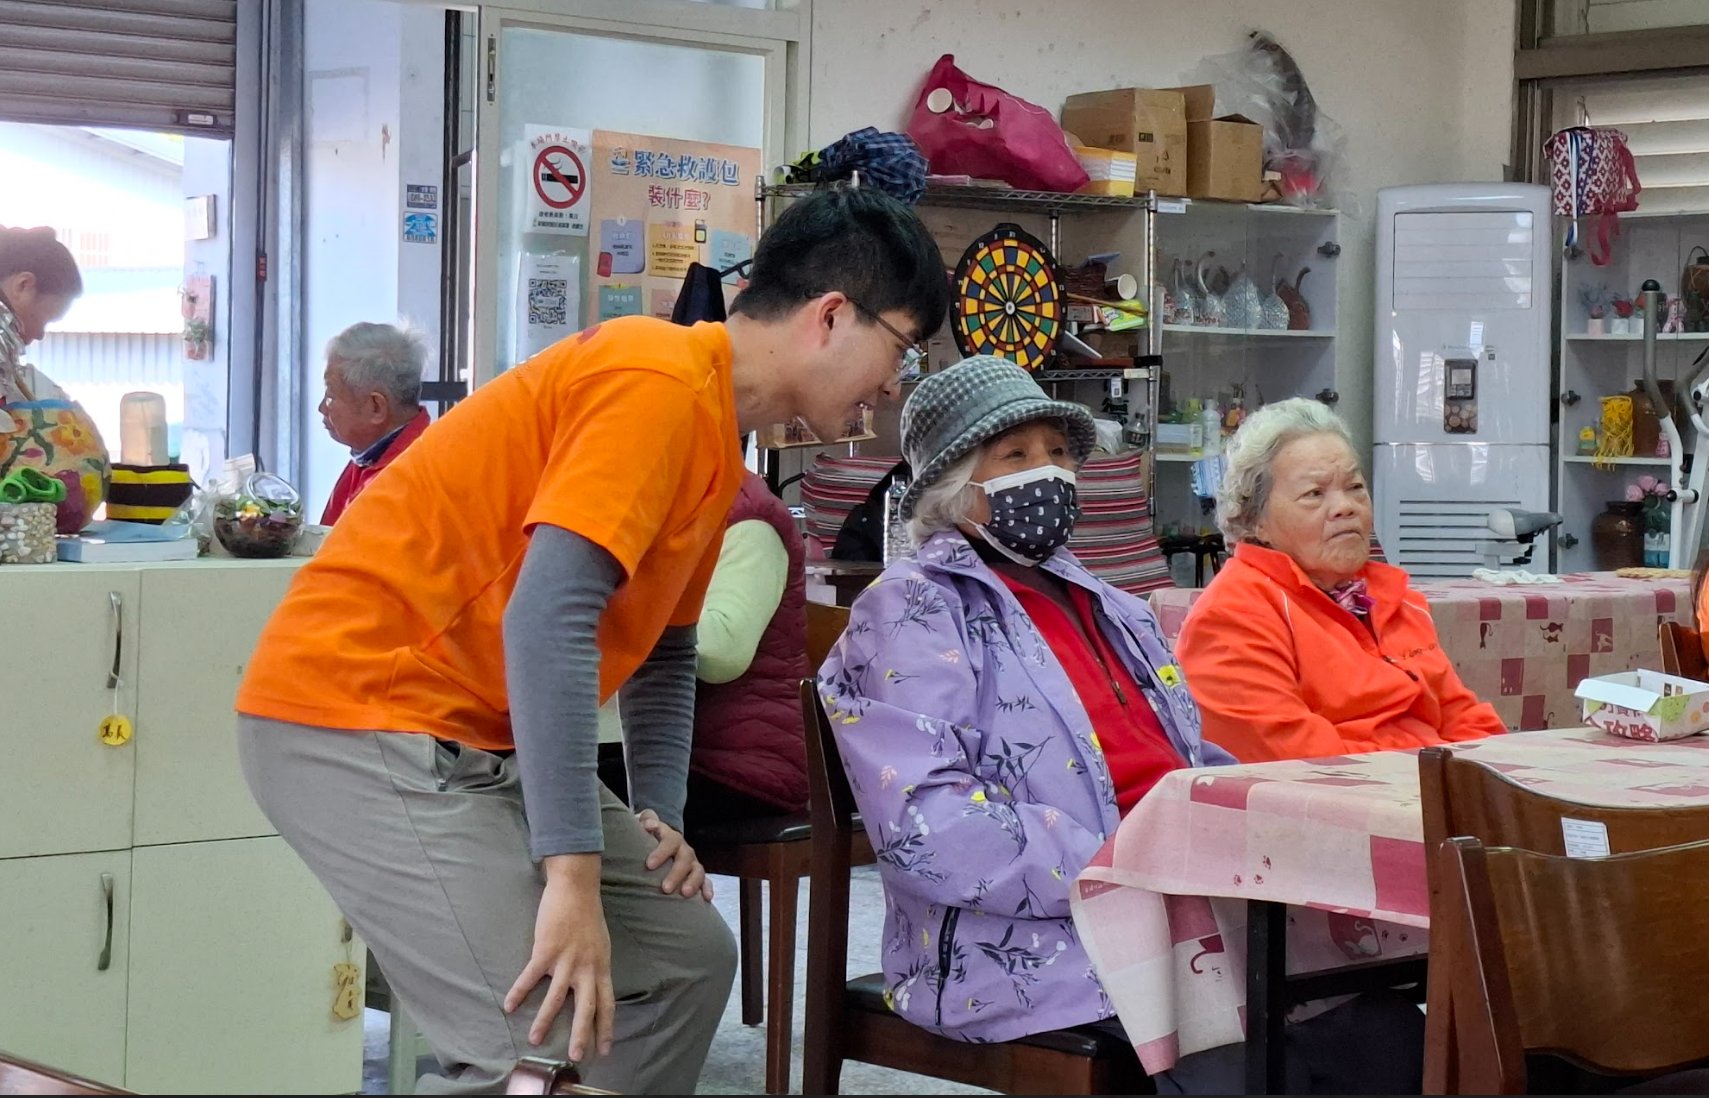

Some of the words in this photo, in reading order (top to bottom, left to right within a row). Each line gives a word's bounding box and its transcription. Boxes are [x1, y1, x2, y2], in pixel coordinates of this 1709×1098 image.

[634, 150, 739, 185] 緊急救護包
